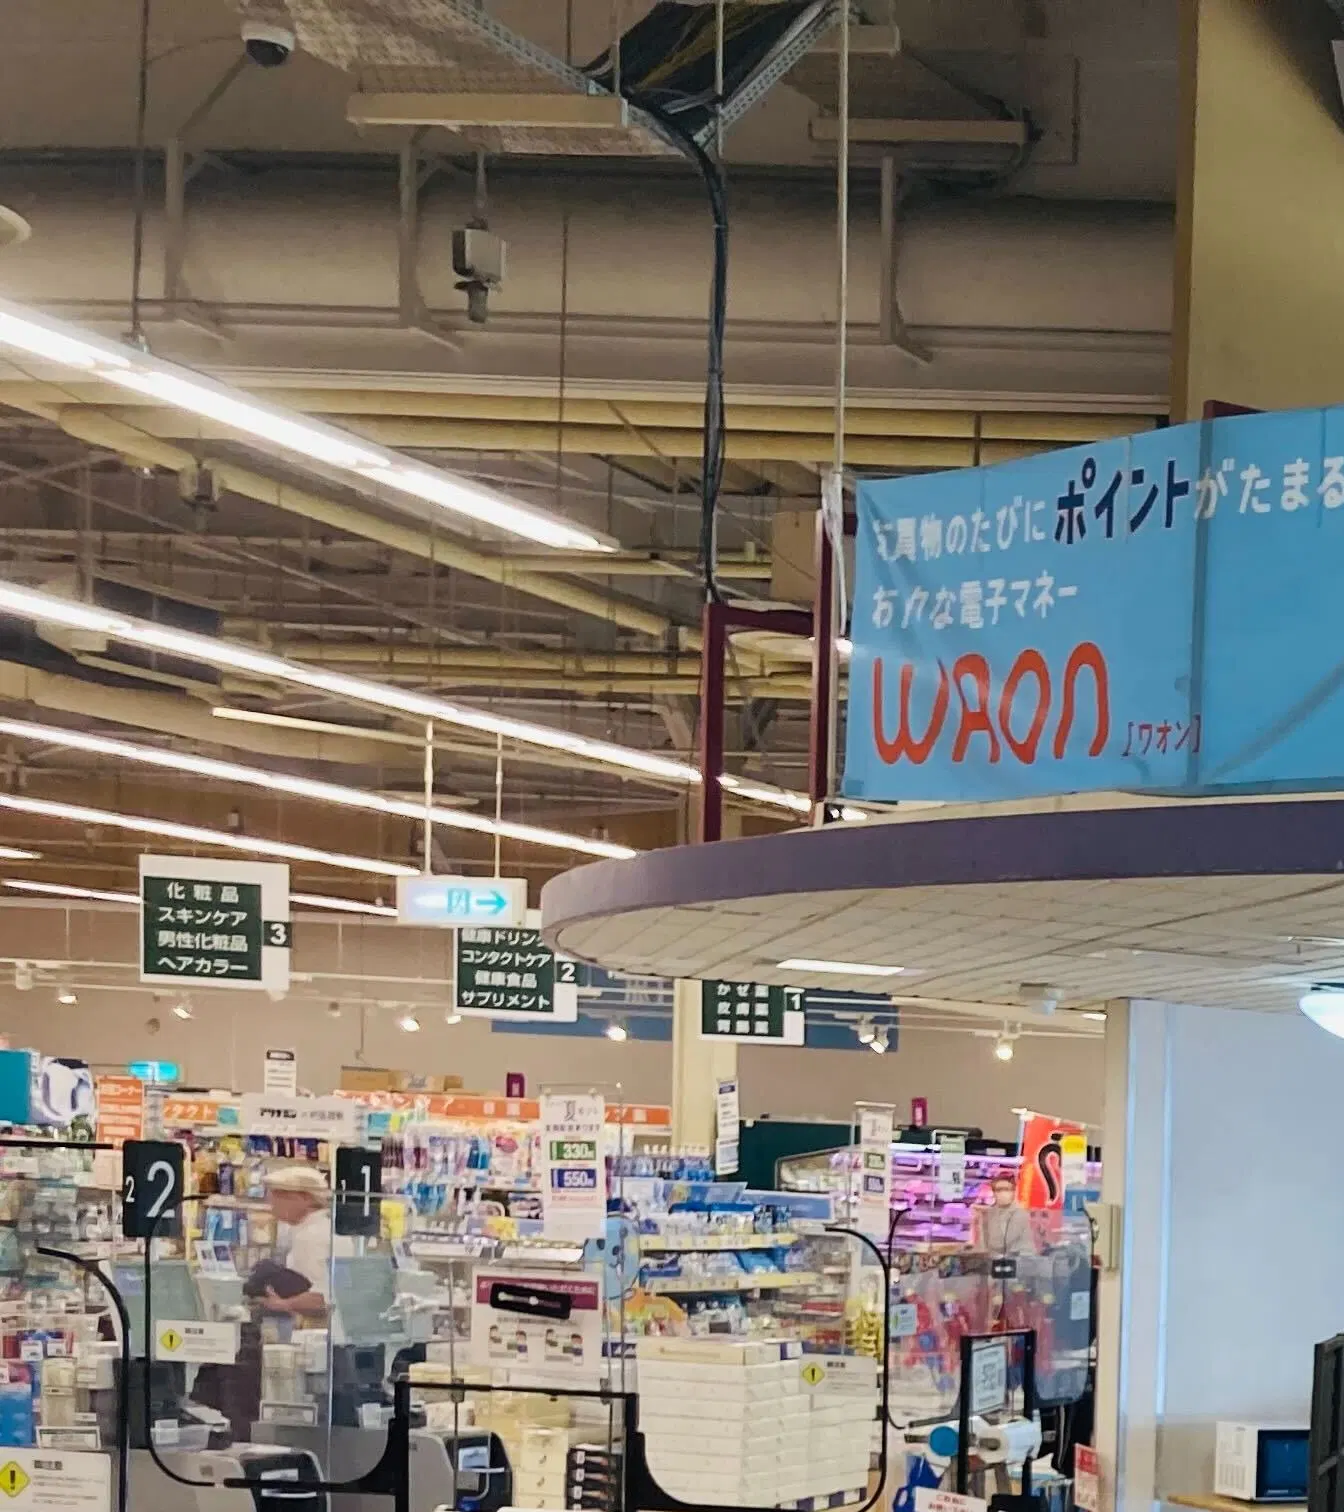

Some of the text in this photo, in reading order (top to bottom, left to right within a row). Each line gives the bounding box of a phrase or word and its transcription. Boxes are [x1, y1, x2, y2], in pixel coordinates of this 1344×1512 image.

[872, 642, 1110, 766] WAON
[167, 882, 239, 903] 化粧品
[158, 906, 247, 927] スキンケア
[157, 930, 248, 952] 男性化粧品
[270, 924, 287, 945] 3
[158, 956, 248, 974] ヘアカラー
[461, 950, 551, 968] コンタクトケア
[561, 965, 576, 982] 2
[461, 990, 550, 1009] サプリメント
[791, 993, 801, 1010] 1
[125, 1175, 135, 1203] 2
[146, 1160, 176, 1218] 2
[361, 1165, 371, 1216] 1
